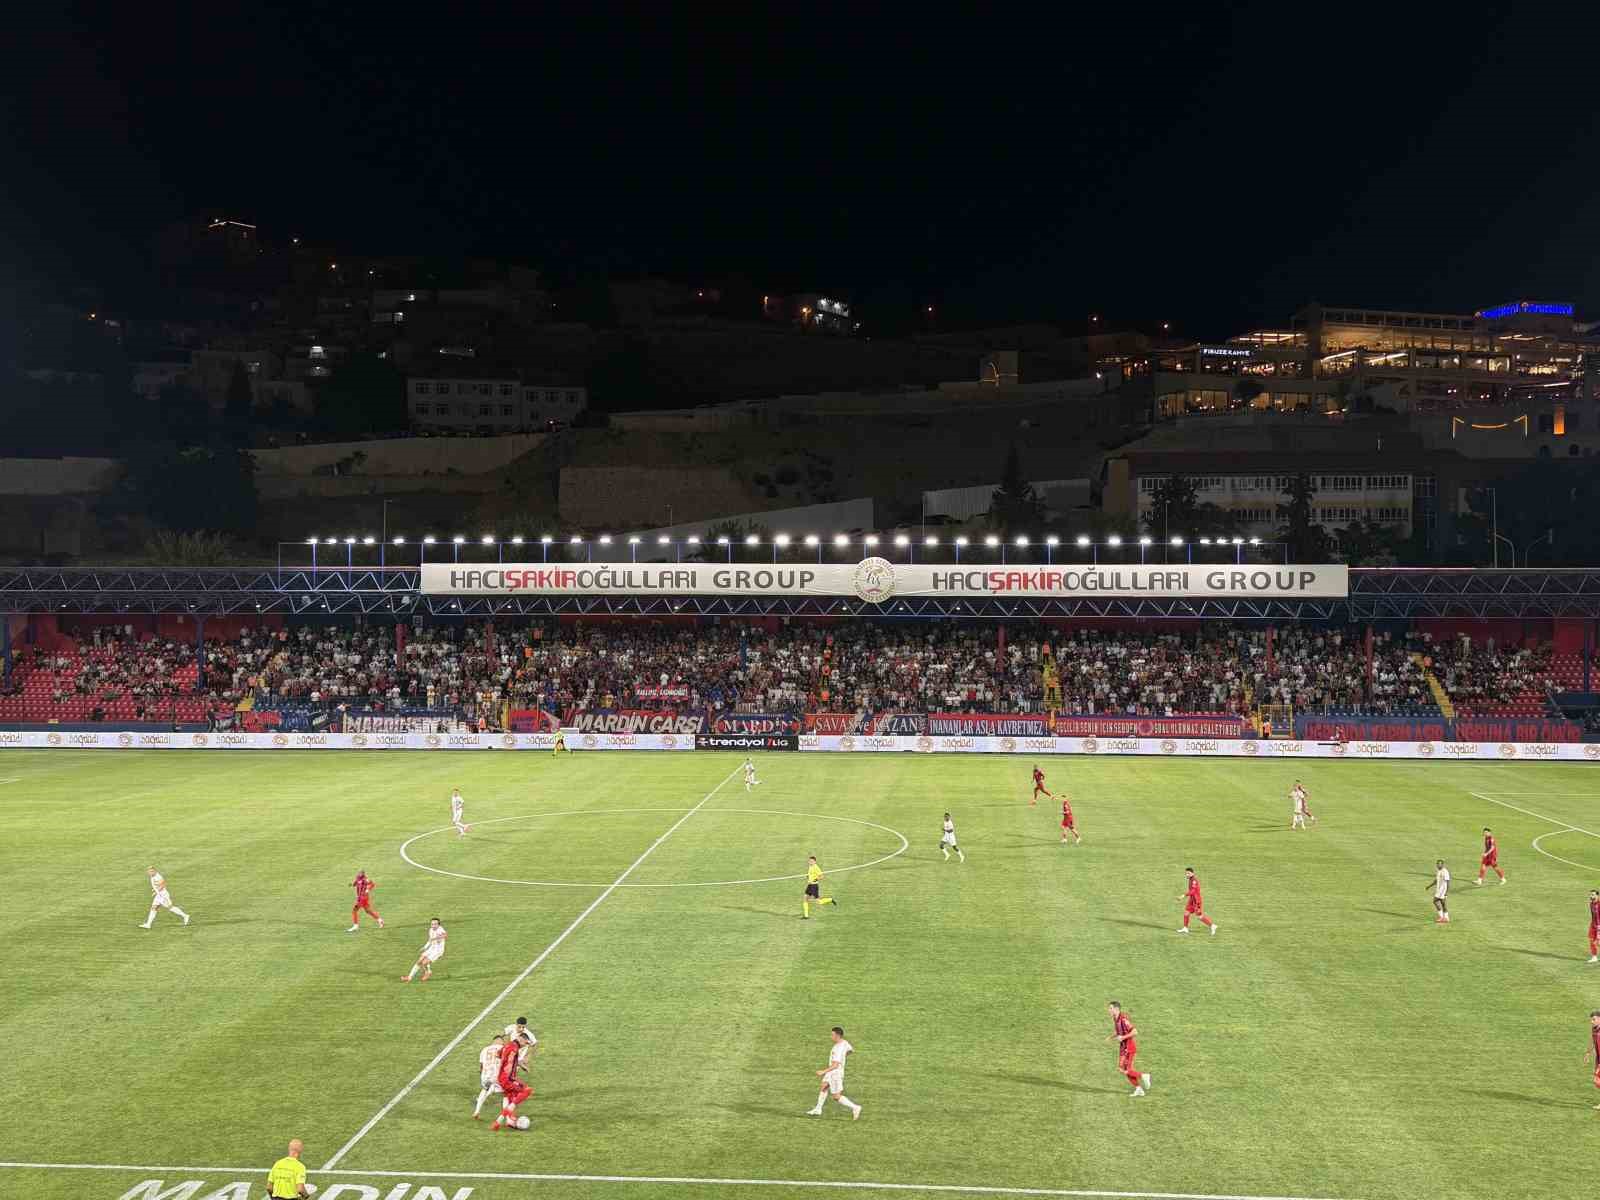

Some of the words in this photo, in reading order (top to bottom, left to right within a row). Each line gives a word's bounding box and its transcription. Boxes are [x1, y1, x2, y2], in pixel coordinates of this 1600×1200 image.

[451, 566, 696, 592] HACIŞAKİROĞULLARI
[713, 570, 815, 589] GROUP
[932, 567, 1189, 594] HACIŞAKİROĞULLARI
[1206, 571, 1316, 590] GROUP
[873, 717, 918, 731] KAZAN
[997, 720, 1043, 735] KAYBETMEZ
[710, 738, 764, 747] trendyol
